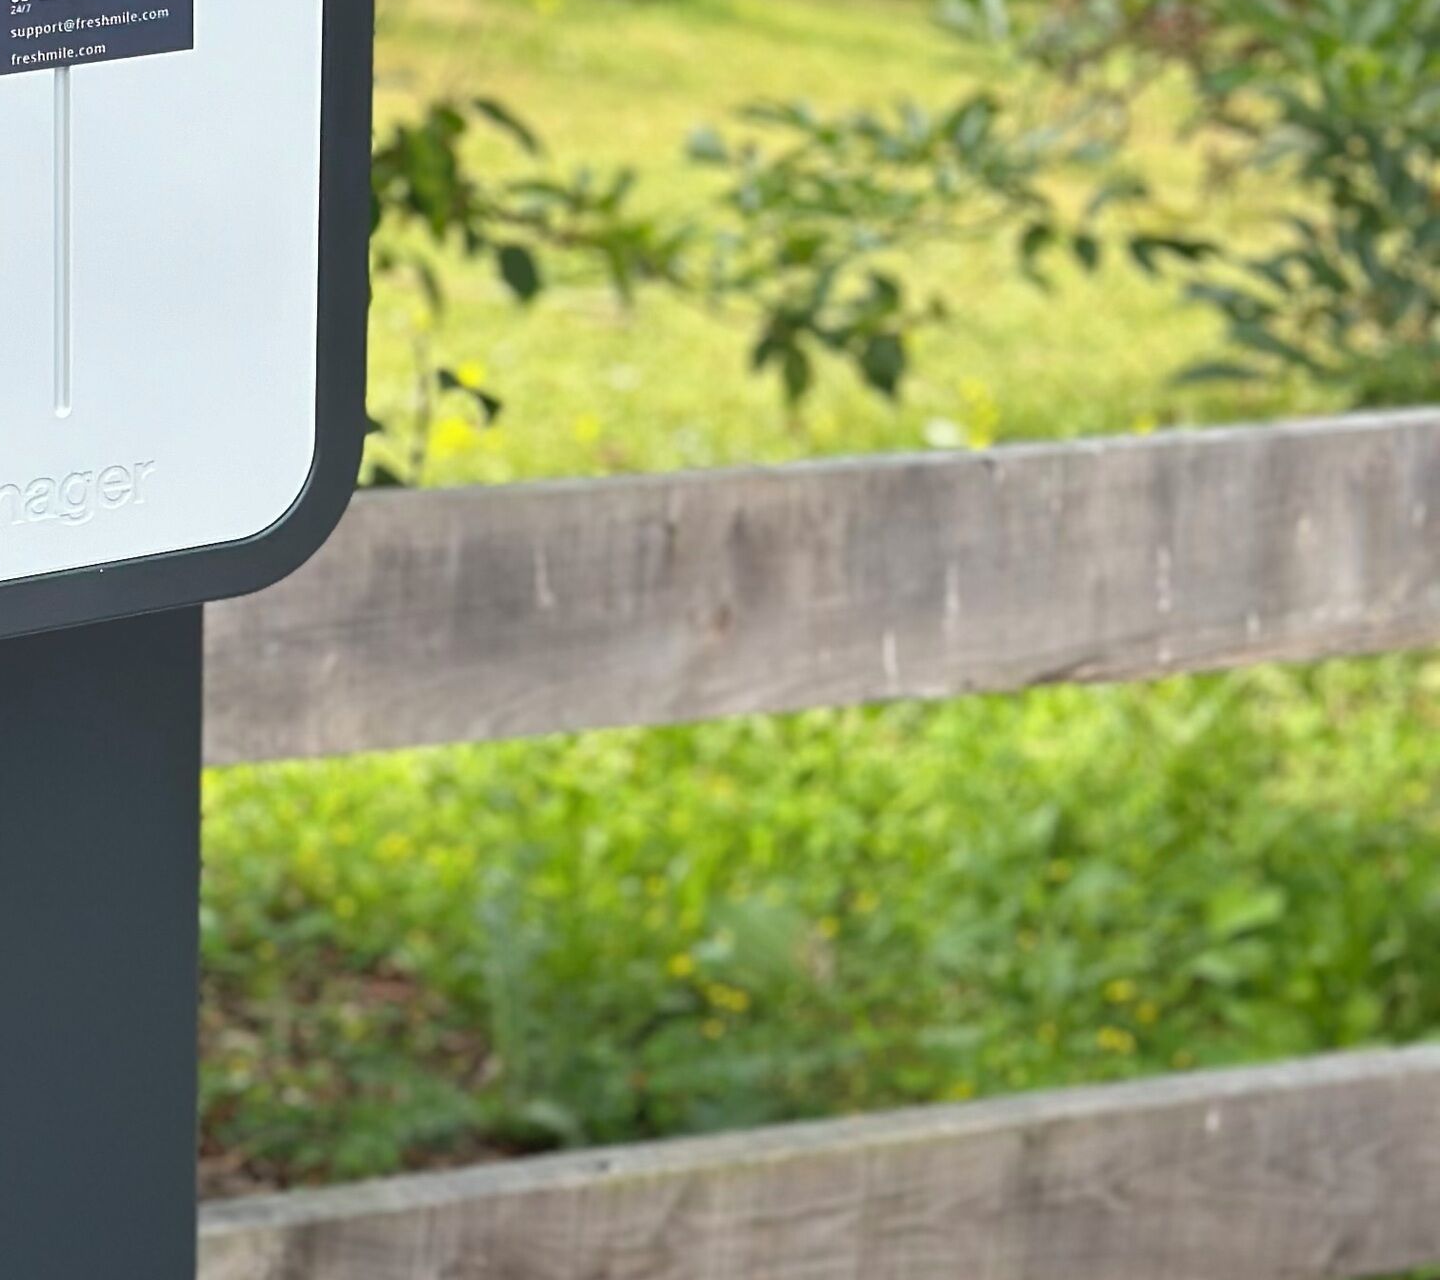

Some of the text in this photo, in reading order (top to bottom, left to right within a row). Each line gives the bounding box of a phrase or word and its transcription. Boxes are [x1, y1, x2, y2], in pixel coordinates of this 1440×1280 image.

[10, 4, 31, 15] 24/7
[10, 8, 170, 39] support@freshmile.com
[10, 43, 106, 66] freshmile.com
